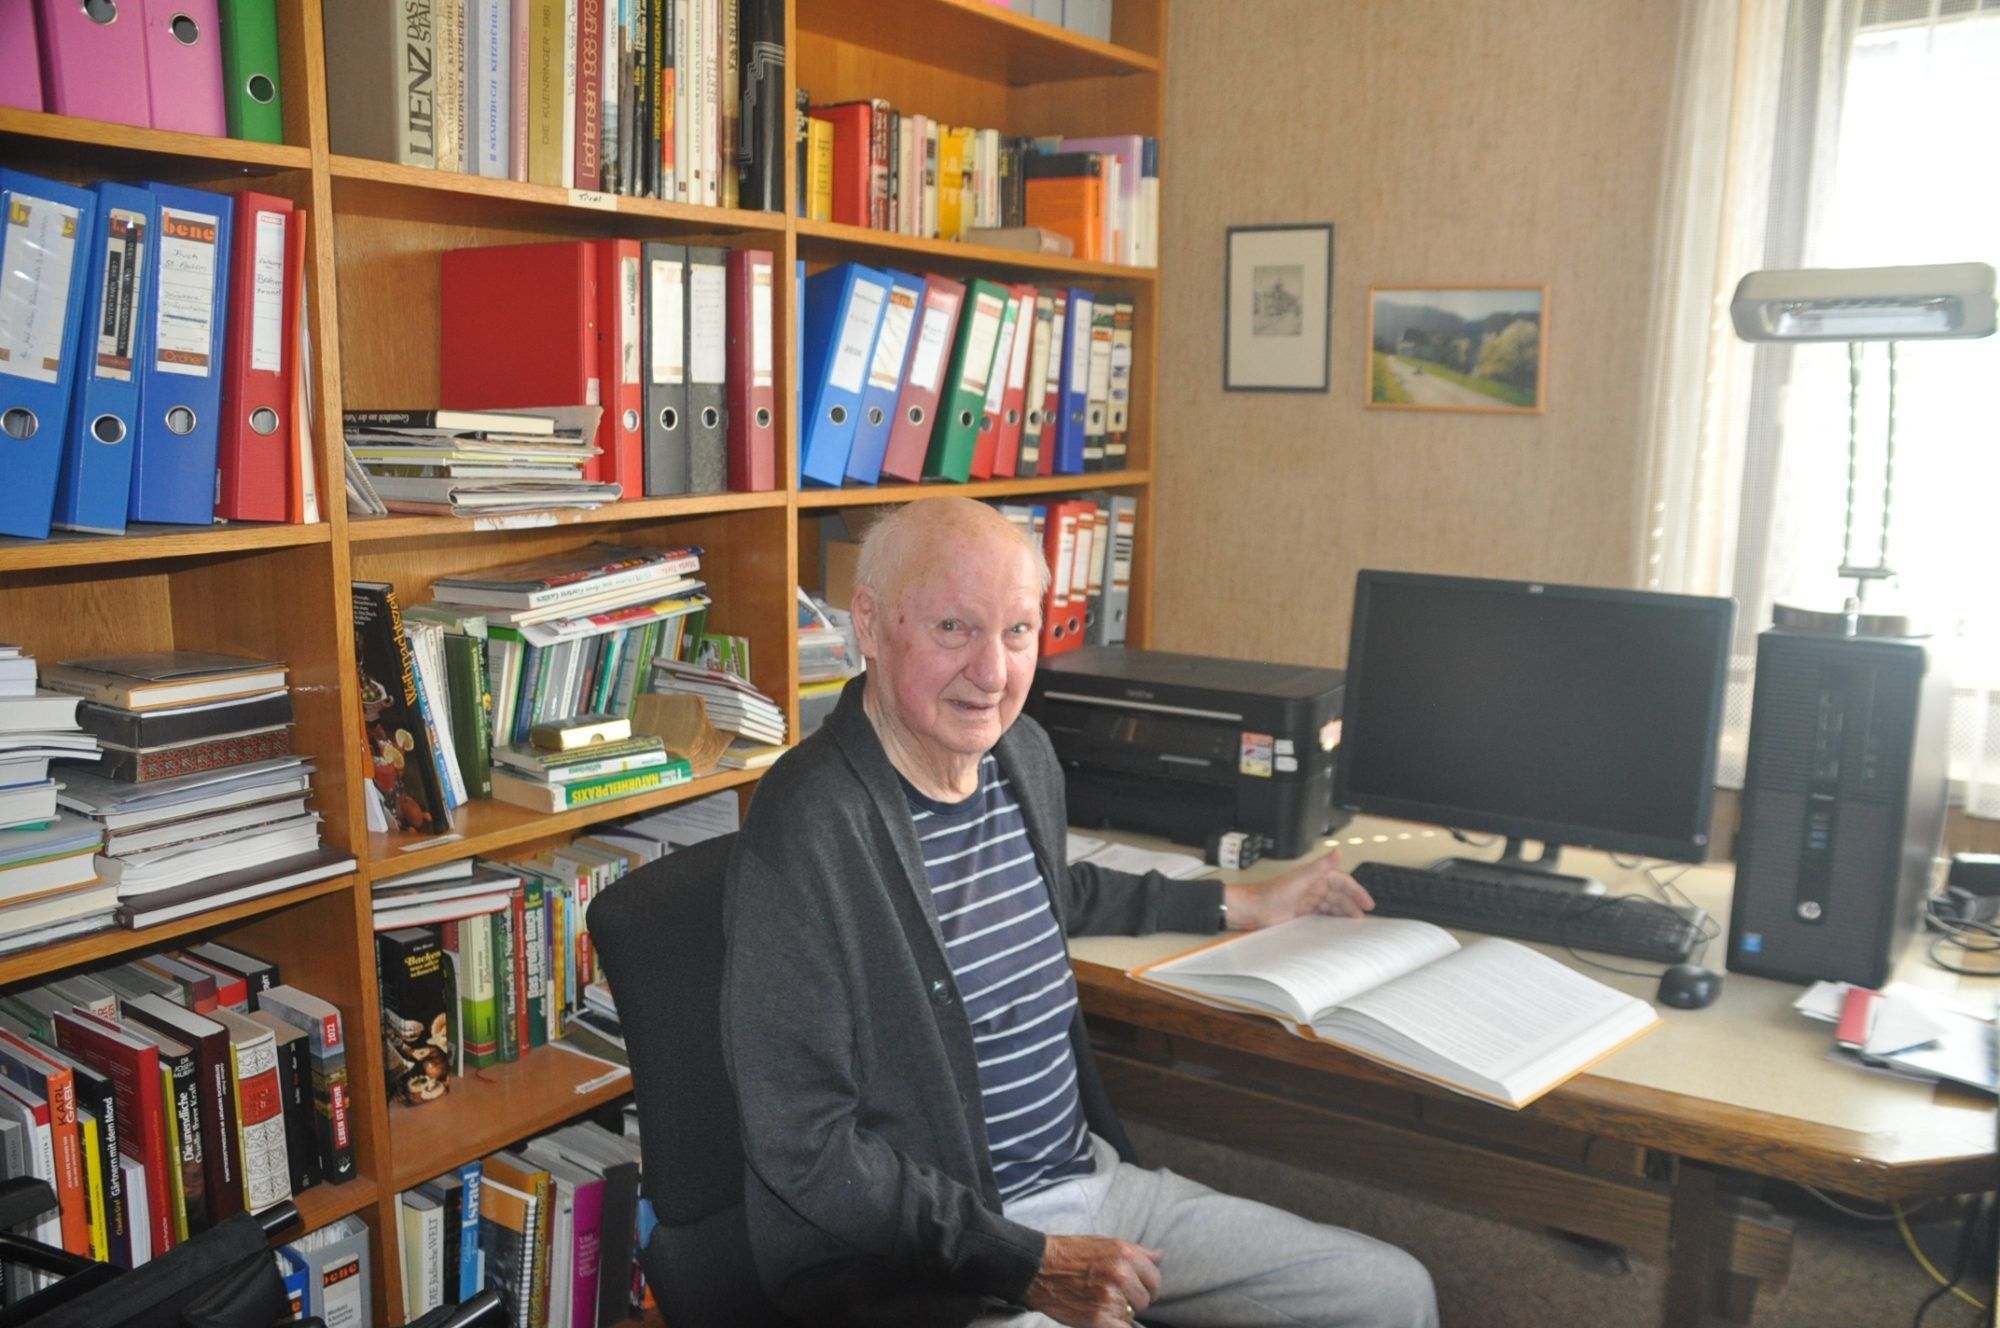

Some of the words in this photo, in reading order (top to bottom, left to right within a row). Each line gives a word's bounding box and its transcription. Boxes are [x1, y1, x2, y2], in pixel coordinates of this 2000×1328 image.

[405, 1, 421, 41] DAS
[490, 1, 498, 73] KITZBÜHEL
[541, 36, 551, 119] KUENRINGER
[707, 55, 717, 104] BERTLE
[407, 43, 434, 158] LIENZ
[490, 78, 498, 151] STADTBUCH
[541, 122, 550, 145] DIE
[581, 81, 597, 178] Liechtenstein
[162, 211, 215, 241] bene
[119, 293, 130, 349] RECHNUNGSBUCH
[164, 350, 204, 366] Ordner
[386, 591, 420, 708] Weihnachtszeit
[571, 772, 660, 804] NATURHEILPRAXIS
[524, 910, 537, 941] Buch
[404, 949, 442, 967] Backen
[526, 941, 539, 976] große
[528, 975, 539, 999] Das
[54, 1083, 66, 1126] KARL
[63, 1080, 75, 1123] GABL
[102, 1096, 114, 1122] Mond
[188, 1083, 198, 1107] Kraft
[333, 1086, 343, 1108] MEHR
[178, 1092, 193, 1143] unendliche
[191, 1108, 200, 1130] Ihrer
[335, 1108, 344, 1120] IST
[105, 1122, 116, 1140] dem
[193, 1131, 203, 1163] Quelle
[336, 1121, 347, 1146] LEBEN
[107, 1141, 117, 1157] mit
[184, 1143, 194, 1162] Die
[109, 1158, 121, 1196] Gärtnern
[462, 1170, 479, 1228] Israel
[114, 1212, 123, 1236] Claudia
[428, 1217, 438, 1249] WELT
[429, 1286, 438, 1306] DIE
